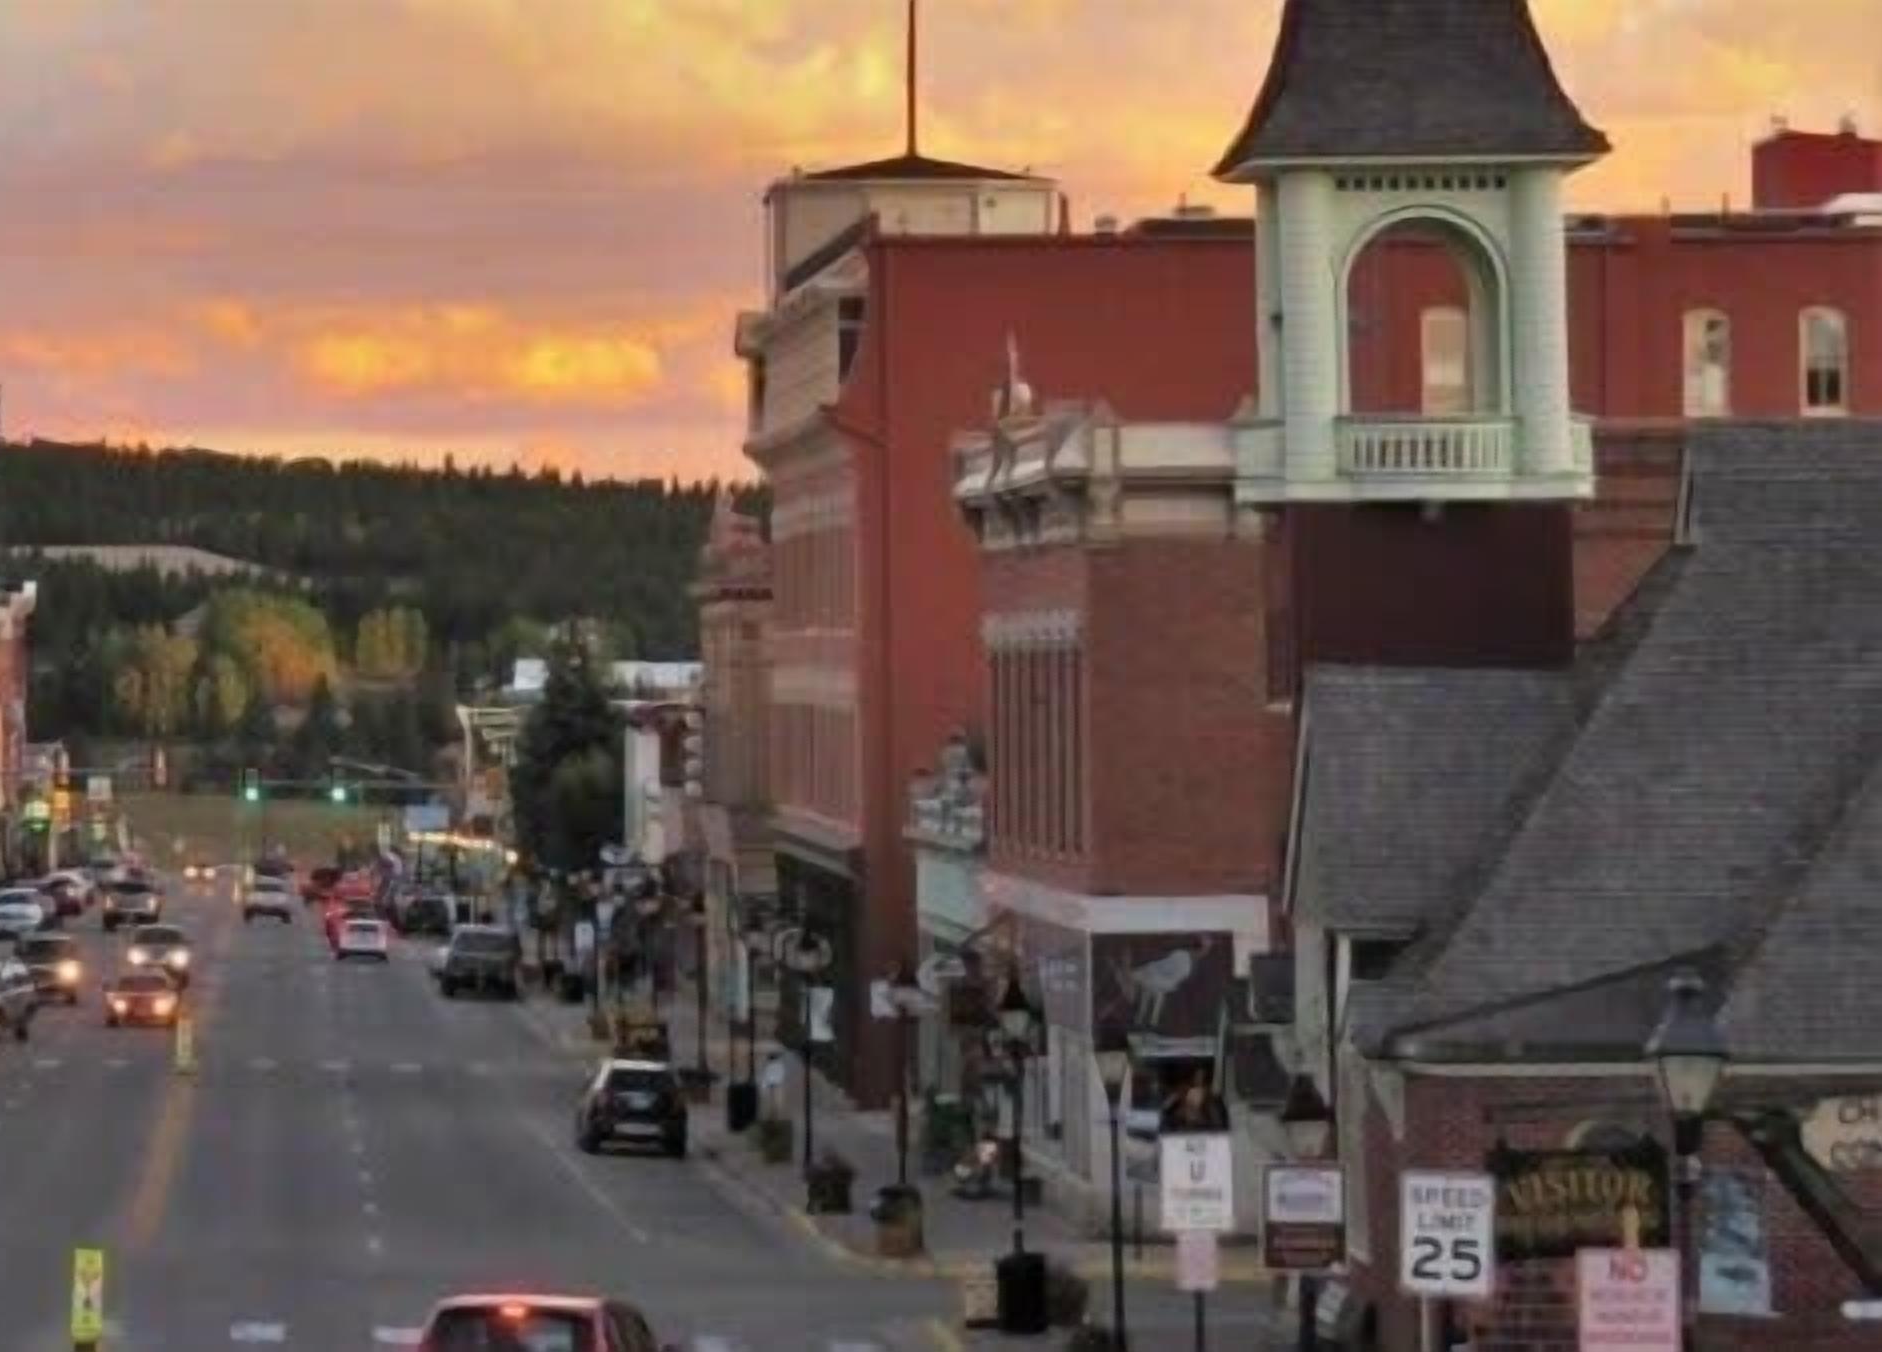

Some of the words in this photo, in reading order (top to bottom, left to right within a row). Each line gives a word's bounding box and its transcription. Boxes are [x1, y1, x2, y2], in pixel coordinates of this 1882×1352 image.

[1413, 1186, 1484, 1208] SPEED
[1508, 1170, 1655, 1213] VISITOR
[1417, 1212, 1476, 1232] LIMIT
[1412, 1236, 1481, 1281] 25
[1608, 1252, 1649, 1283] NO
